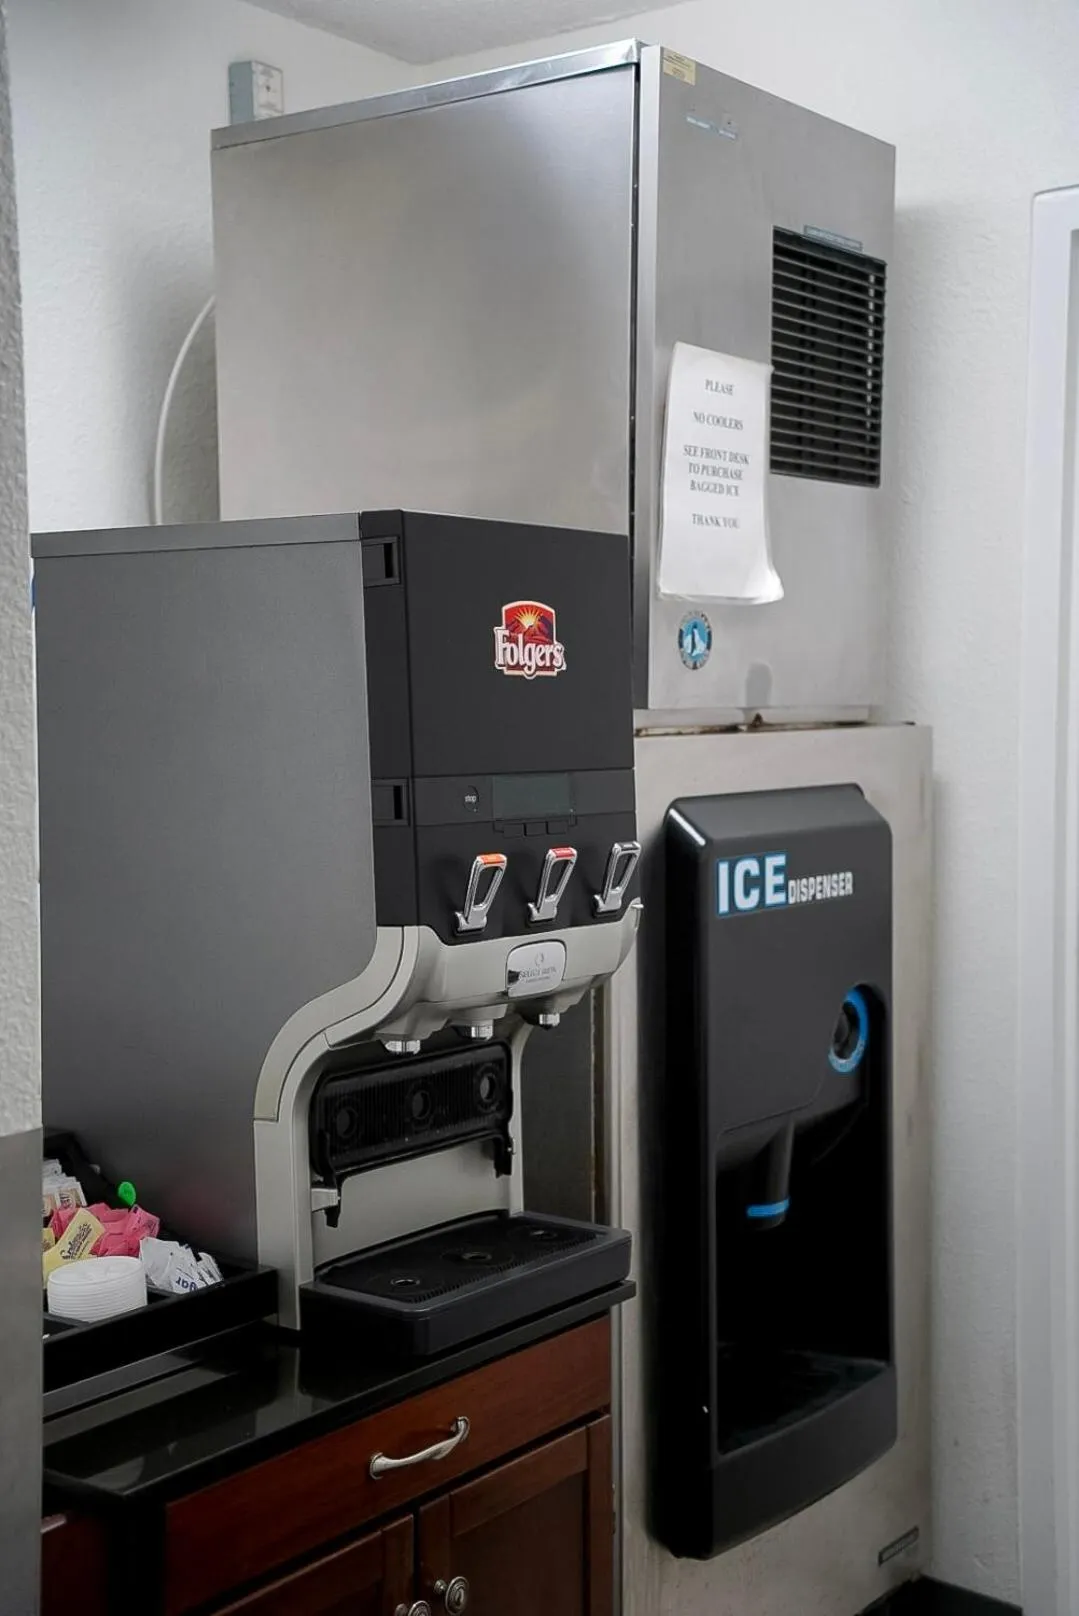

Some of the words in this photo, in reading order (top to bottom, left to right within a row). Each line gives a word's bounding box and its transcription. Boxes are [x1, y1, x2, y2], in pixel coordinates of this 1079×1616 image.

[705, 380, 733, 396] PLEASE
[693, 411, 705, 424] NO
[706, 415, 744, 431] COOLERS
[683, 445, 698, 457] SEE
[700, 448, 727, 462] FRONT
[728, 450, 750, 465] DESK
[688, 462, 700, 474] TO
[701, 464, 743, 480] PURCHASE
[690, 479, 725, 495] BAGGED
[726, 483, 740, 496] ICE
[692, 514, 720, 528] THANK
[722, 517, 739, 529] YOU
[495, 628, 565, 675] Folgers
[717, 852, 786, 914] ICE
[787, 871, 854, 905] DISPENSER
